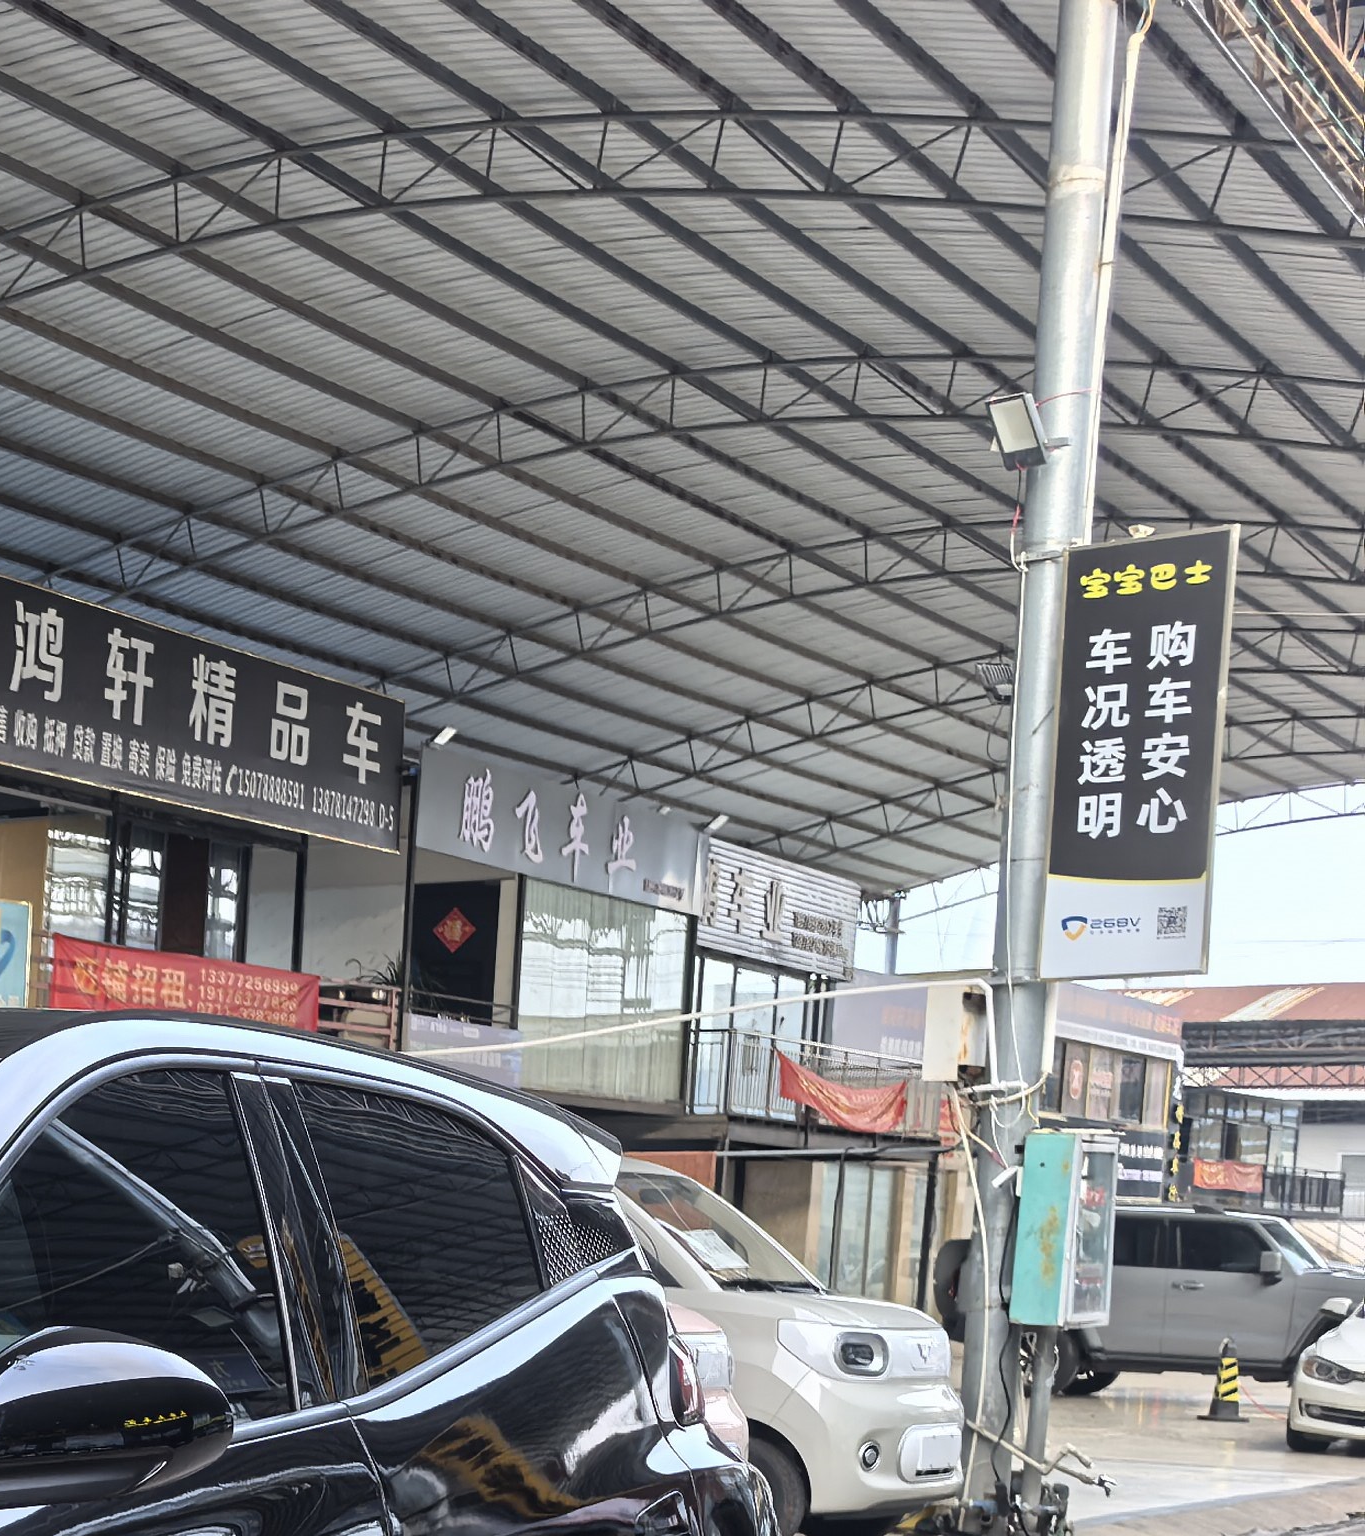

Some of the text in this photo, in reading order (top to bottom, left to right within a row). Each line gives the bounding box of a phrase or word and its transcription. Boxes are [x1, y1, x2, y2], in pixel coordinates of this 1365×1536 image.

[1080, 560, 1212, 598] 宝宝巴士
[9, 600, 382, 785] 鸿轩精品车
[1076, 629, 1132, 839] 车况透明
[1136, 620, 1196, 834] 购车安心
[458, 768, 636, 883] 鹏飞车业
[1090, 917, 1141, 929] 268V
